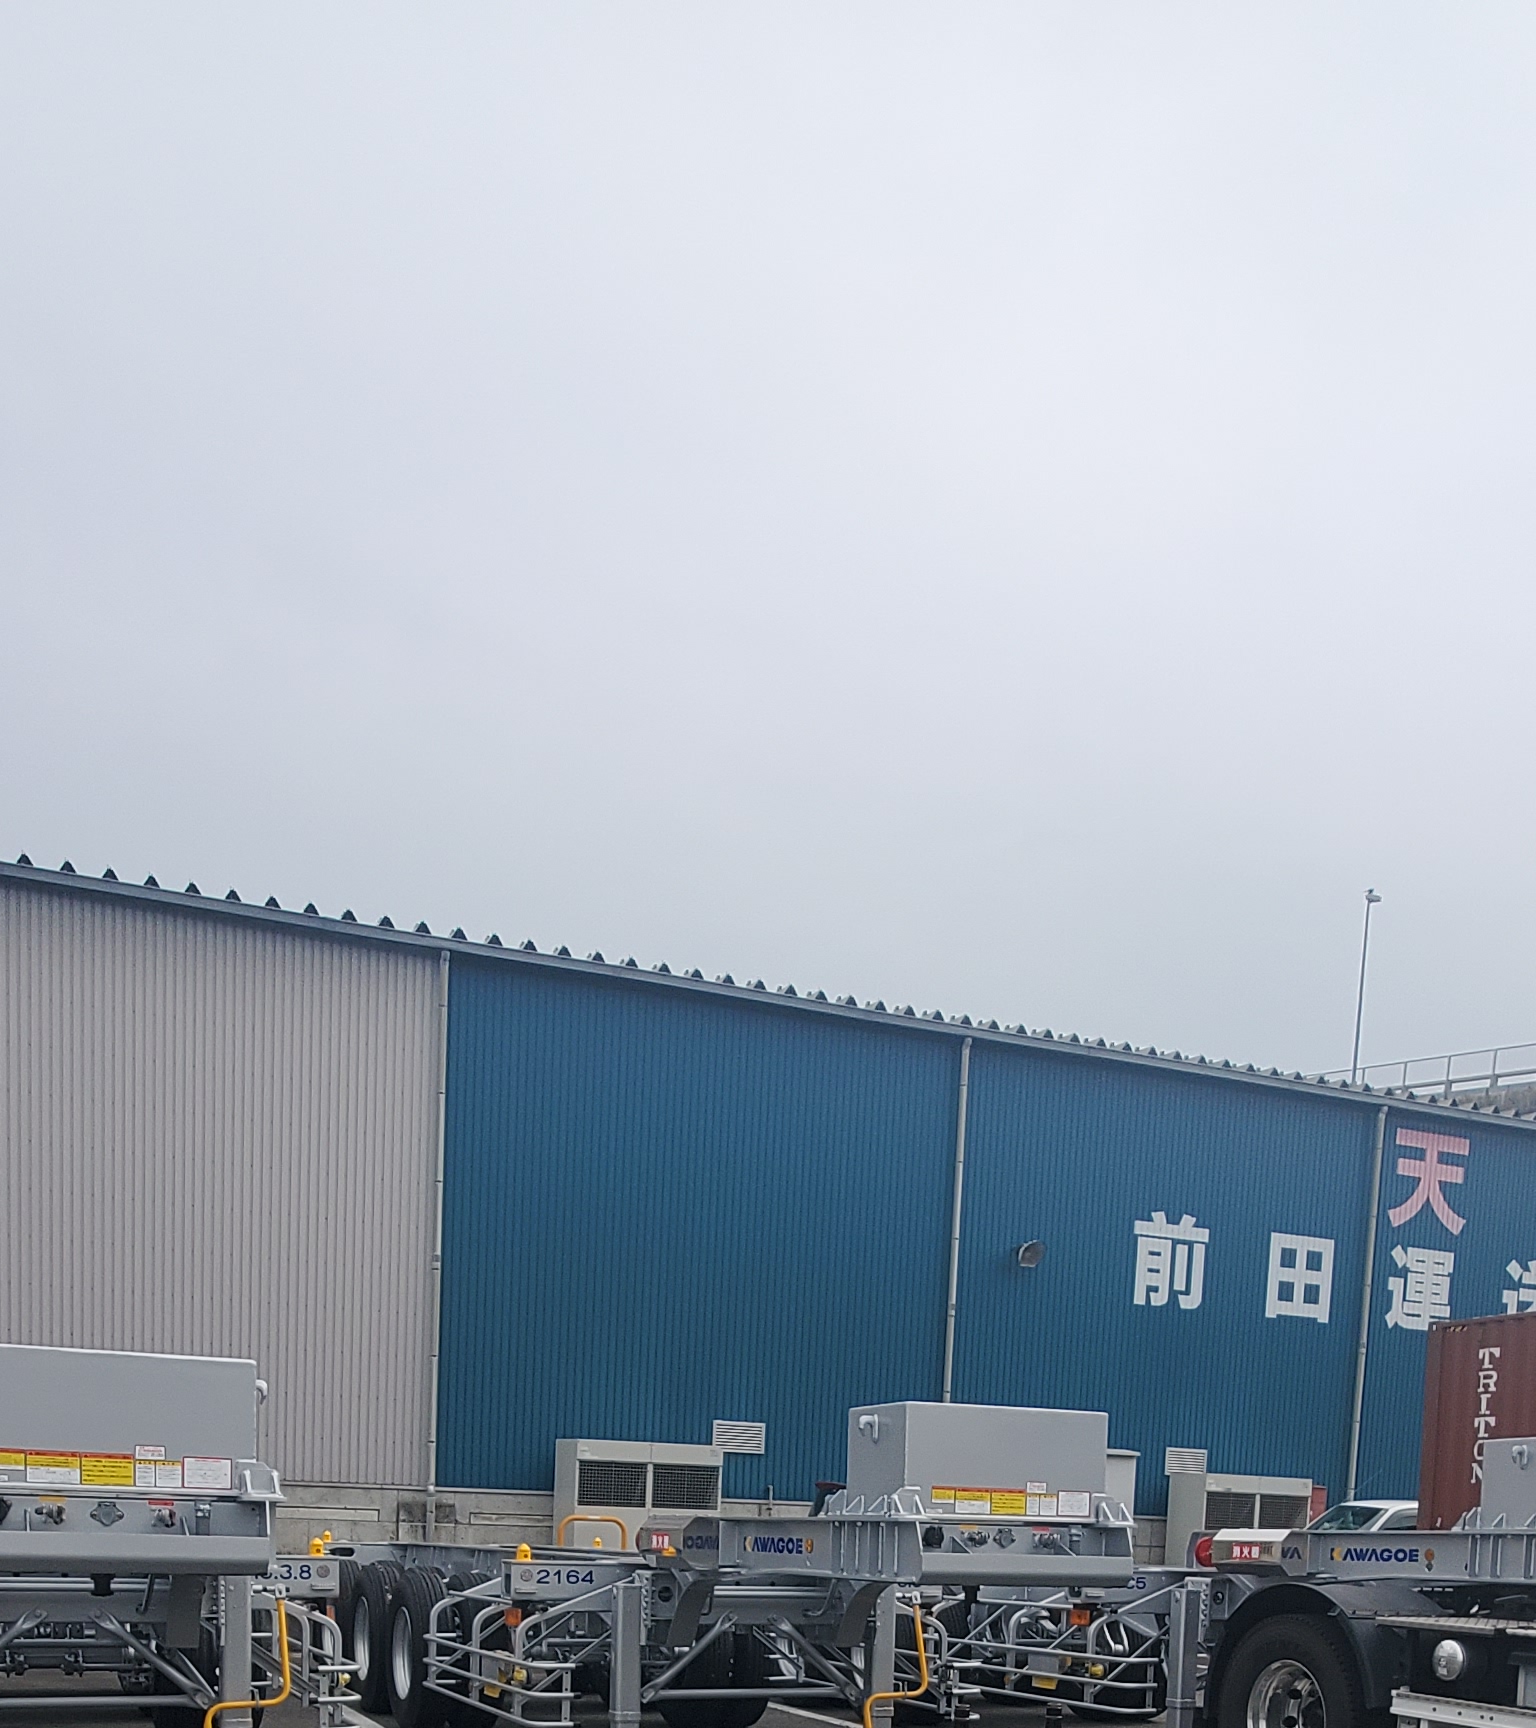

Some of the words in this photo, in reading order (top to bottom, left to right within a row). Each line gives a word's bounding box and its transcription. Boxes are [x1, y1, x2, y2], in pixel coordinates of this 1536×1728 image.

[1388, 1127, 1470, 1236] 天
[744, 1536, 803, 1554] KAWAGOE
[1330, 1547, 1419, 1562] KAWAGOE
[536, 1569, 594, 1584] 2164
